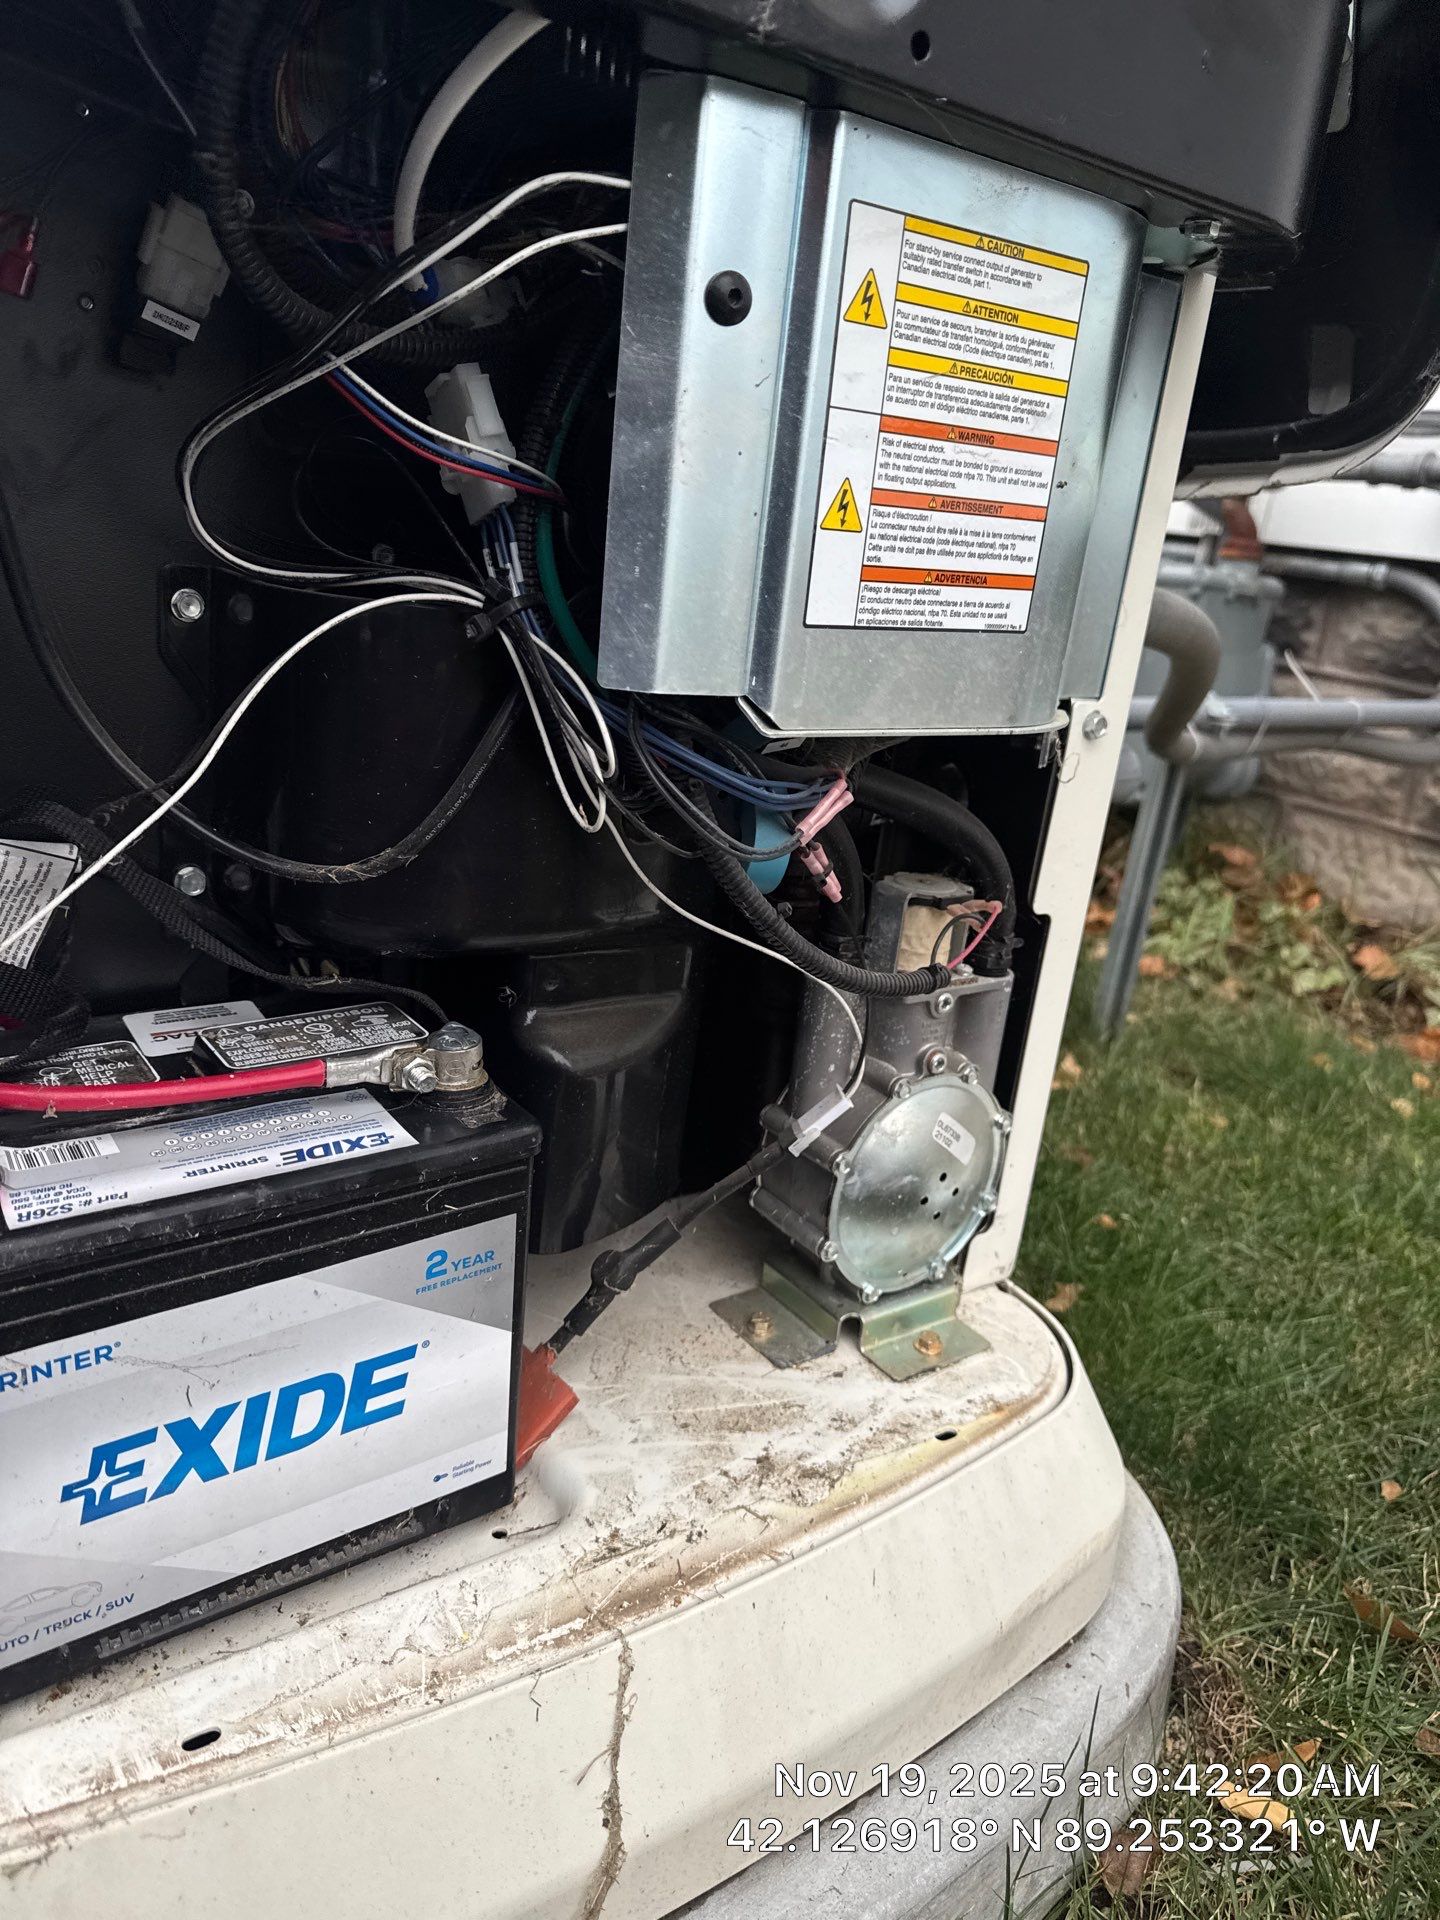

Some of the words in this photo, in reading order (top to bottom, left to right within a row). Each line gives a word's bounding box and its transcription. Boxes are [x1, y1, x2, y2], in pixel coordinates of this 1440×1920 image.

[986, 240, 1024, 258] CAUTION
[904, 238, 916, 250] For
[915, 243, 942, 259] stand-by
[941, 250, 963, 262] service
[963, 255, 986, 268] connect
[985, 261, 1004, 272] output
[1003, 264, 1011, 274] of
[1010, 267, 1037, 280] generator
[1036, 273, 1043, 282] to
[901, 260, 931, 275] Canadian
[930, 268, 957, 282] electrical
[972, 279, 986, 289] part
[903, 251, 927, 266] suitably
[926, 257, 943, 268] rated
[942, 260, 965, 273] transfer
[964, 266, 983, 278] switch
[983, 269, 990, 279] in
[1021, 279, 1033, 290] with
[972, 304, 1019, 324] ATTENTION
[895, 308, 911, 320] Pour
[910, 314, 920, 322] un
[919, 315, 941, 327] service
[940, 319, 950, 328] de
[973, 325, 999, 338] brancher
[1019, 335, 1028, 345] du
[893, 329, 922, 343] Canadian
[922, 336, 948, 349] electrical
[947, 342, 963, 352] code
[894, 320, 903, 329] au
[903, 322, 942, 337] commutateur
[941, 329, 950, 339] de
[950, 331, 974, 343] transfert
[1042, 351, 1050, 359] au
[959, 365, 1014, 385] PRECAUCIÓN
[881, 436, 896, 447] Risk
[895, 439, 903, 448] of
[902, 440, 928, 452] electrical
[958, 430, 995, 446] WARNING
[880, 448, 893, 459] The
[892, 452, 913, 461] neutral
[912, 454, 941, 465] conductor
[940, 458, 955, 467] must
[954, 458, 963, 468] be
[962, 460, 984, 471] bonded
[983, 462, 990, 472] to
[989, 464, 1009, 474] ground
[1008, 465, 1014, 474] in
[877, 472, 884, 481] in
[883, 472, 905, 486] floating
[905, 476, 924, 487] output
[923, 478, 957, 490] applications.
[878, 460, 891, 470] with
[891, 462, 902, 472] the
[901, 464, 925, 474] national
[924, 466, 950, 478] electrical
[949, 470, 963, 479] code
[976, 472, 985, 482] 70.
[985, 473, 997, 483] This
[997, 476, 1008, 485] unit
[1007, 477, 1021, 486] shall
[1019, 479, 1029, 487] not
[1028, 479, 1036, 489] be
[1036, 481, 1049, 490] used
[939, 499, 1004, 515] AVERTISSEMENT
[933, 573, 988, 586] ADVERTENCIA
[446, 792, 467, 816] PLASTIC
[244, 1006, 385, 1032] DANGER/POISON
[392, 1020, 411, 1028] ACID
[226, 1044, 274, 1056] EXPLOSIVE
[241, 1038, 274, 1049] SHIELD
[276, 1035, 298, 1044] EYES
[50, 1056, 74, 1064] TIGHT
[77, 1052, 96, 1060] AND
[230, 1051, 261, 1062] GASES
[280, 1046, 306, 1055] CAUSE
[234, 1055, 278, 1067] BLINDNESS
[72, 1059, 97, 1068] GET
[76, 1061, 134, 1074] MEDICAL
[80, 1071, 114, 1081] HELP
[84, 1078, 117, 1086] FAST
[276, 1130, 398, 1165] EXIDE
[183, 1155, 269, 1178] SPRINTER
[62, 1190, 92, 1200] Group
[65, 1186, 86, 1194] CCA
[96, 1190, 129, 1204] Part
[13, 1202, 33, 1211] 26R
[36, 1197, 59, 1206] Size:
[77, 1198, 93, 1207] #:
[16, 1202, 74, 1223] S26R
[426, 1250, 448, 1280] 2
[451, 1250, 495, 1271] YEAR
[416, 1283, 438, 1295] FREE
[440, 1263, 503, 1287] REPLACEMENT
[453, 1460, 475, 1471] Reliable
[453, 1466, 474, 1478] Starting
[475, 1459, 492, 1470] Power
[34, 1628, 39, 1640] /
[43, 1610, 92, 1634] TRUCK
[96, 1606, 101, 1616] /
[106, 1593, 135, 1611] SUV
